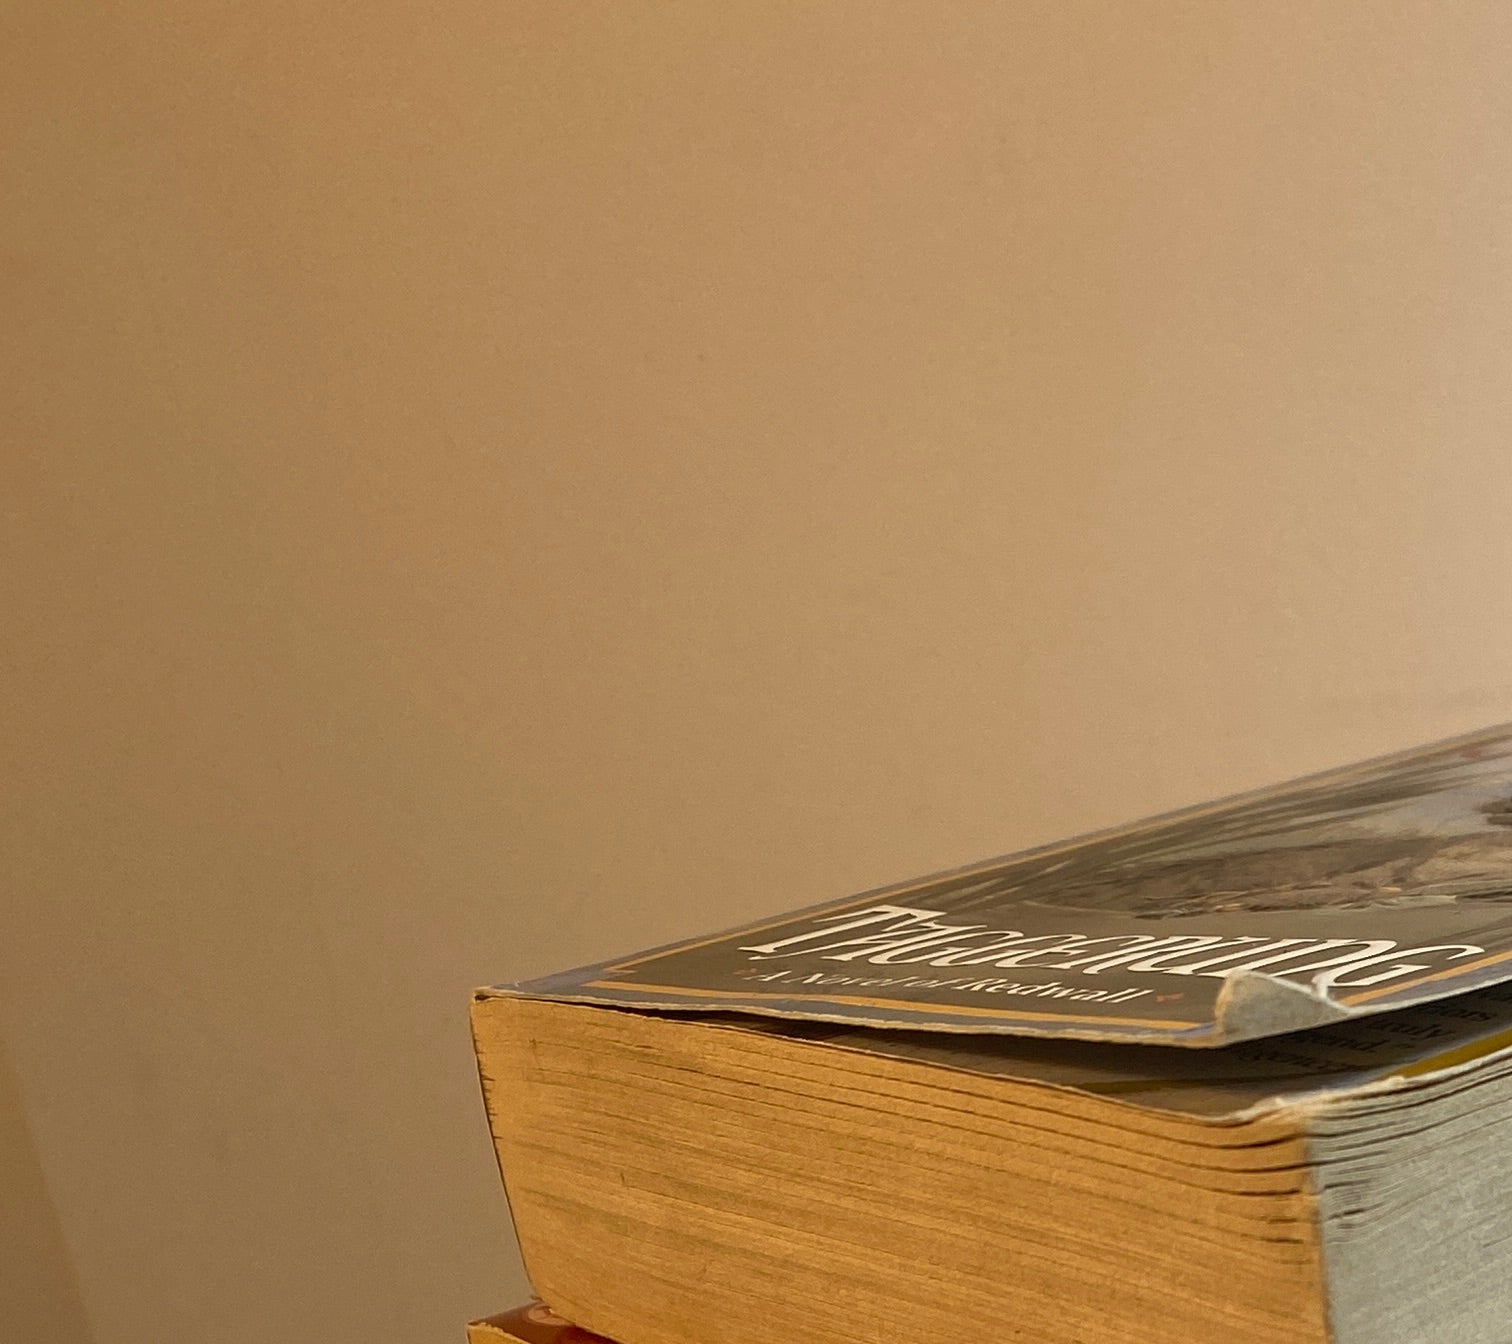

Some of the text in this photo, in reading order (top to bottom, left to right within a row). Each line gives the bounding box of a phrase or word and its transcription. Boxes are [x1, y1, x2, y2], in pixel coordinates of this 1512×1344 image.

[737, 904, 1486, 991] TAGGERUNG
[742, 970, 1156, 1004] A Novel of Redwall
